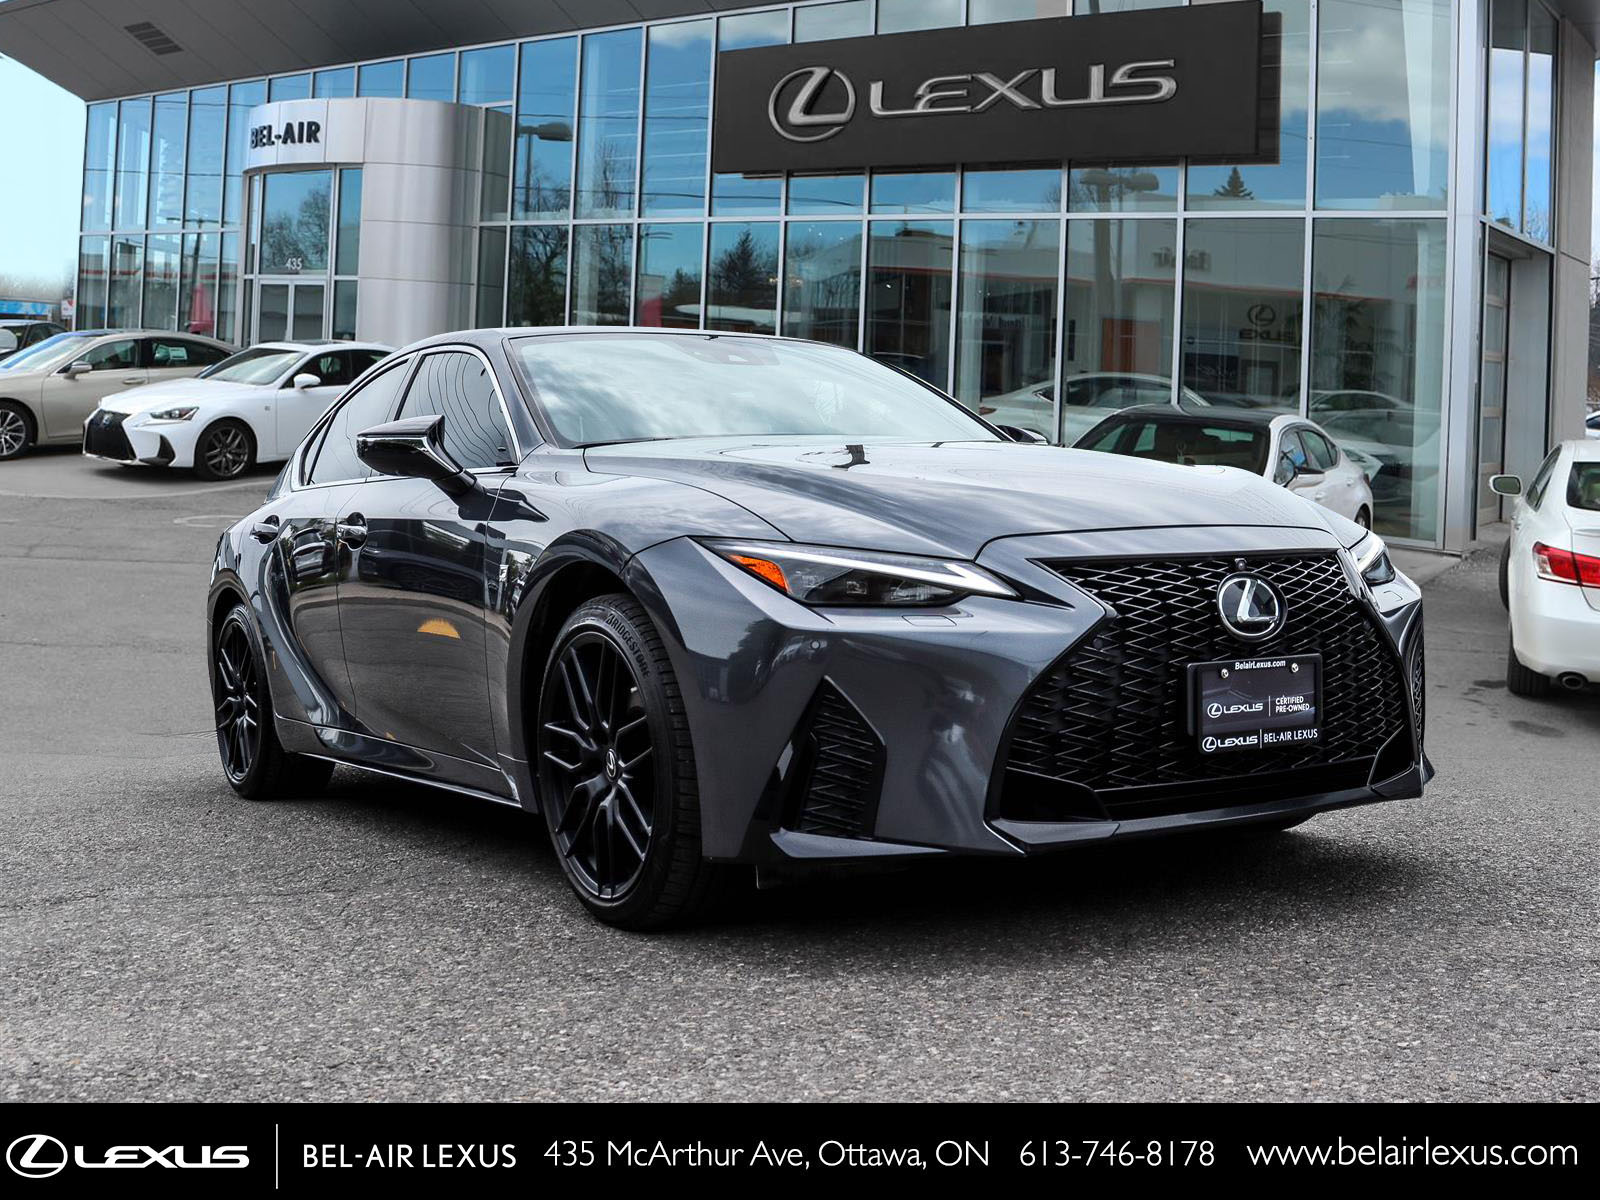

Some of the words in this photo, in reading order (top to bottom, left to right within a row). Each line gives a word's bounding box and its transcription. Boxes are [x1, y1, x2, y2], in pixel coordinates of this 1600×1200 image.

[869, 58, 1177, 119] LEXUS
[250, 121, 321, 149] BEL-AIR
[285, 258, 303, 270] 435
[1234, 660, 1286, 670] BelairLexus.com
[1275, 696, 1304, 705] CERTIFIED
[1223, 703, 1264, 714] LEXUS
[1275, 703, 1310, 713] PRE-OWNED
[1217, 736, 1258, 747] LEXUS
[1263, 731, 1292, 743] BEL-AIR
[1293, 729, 1318, 740] LEXUS
